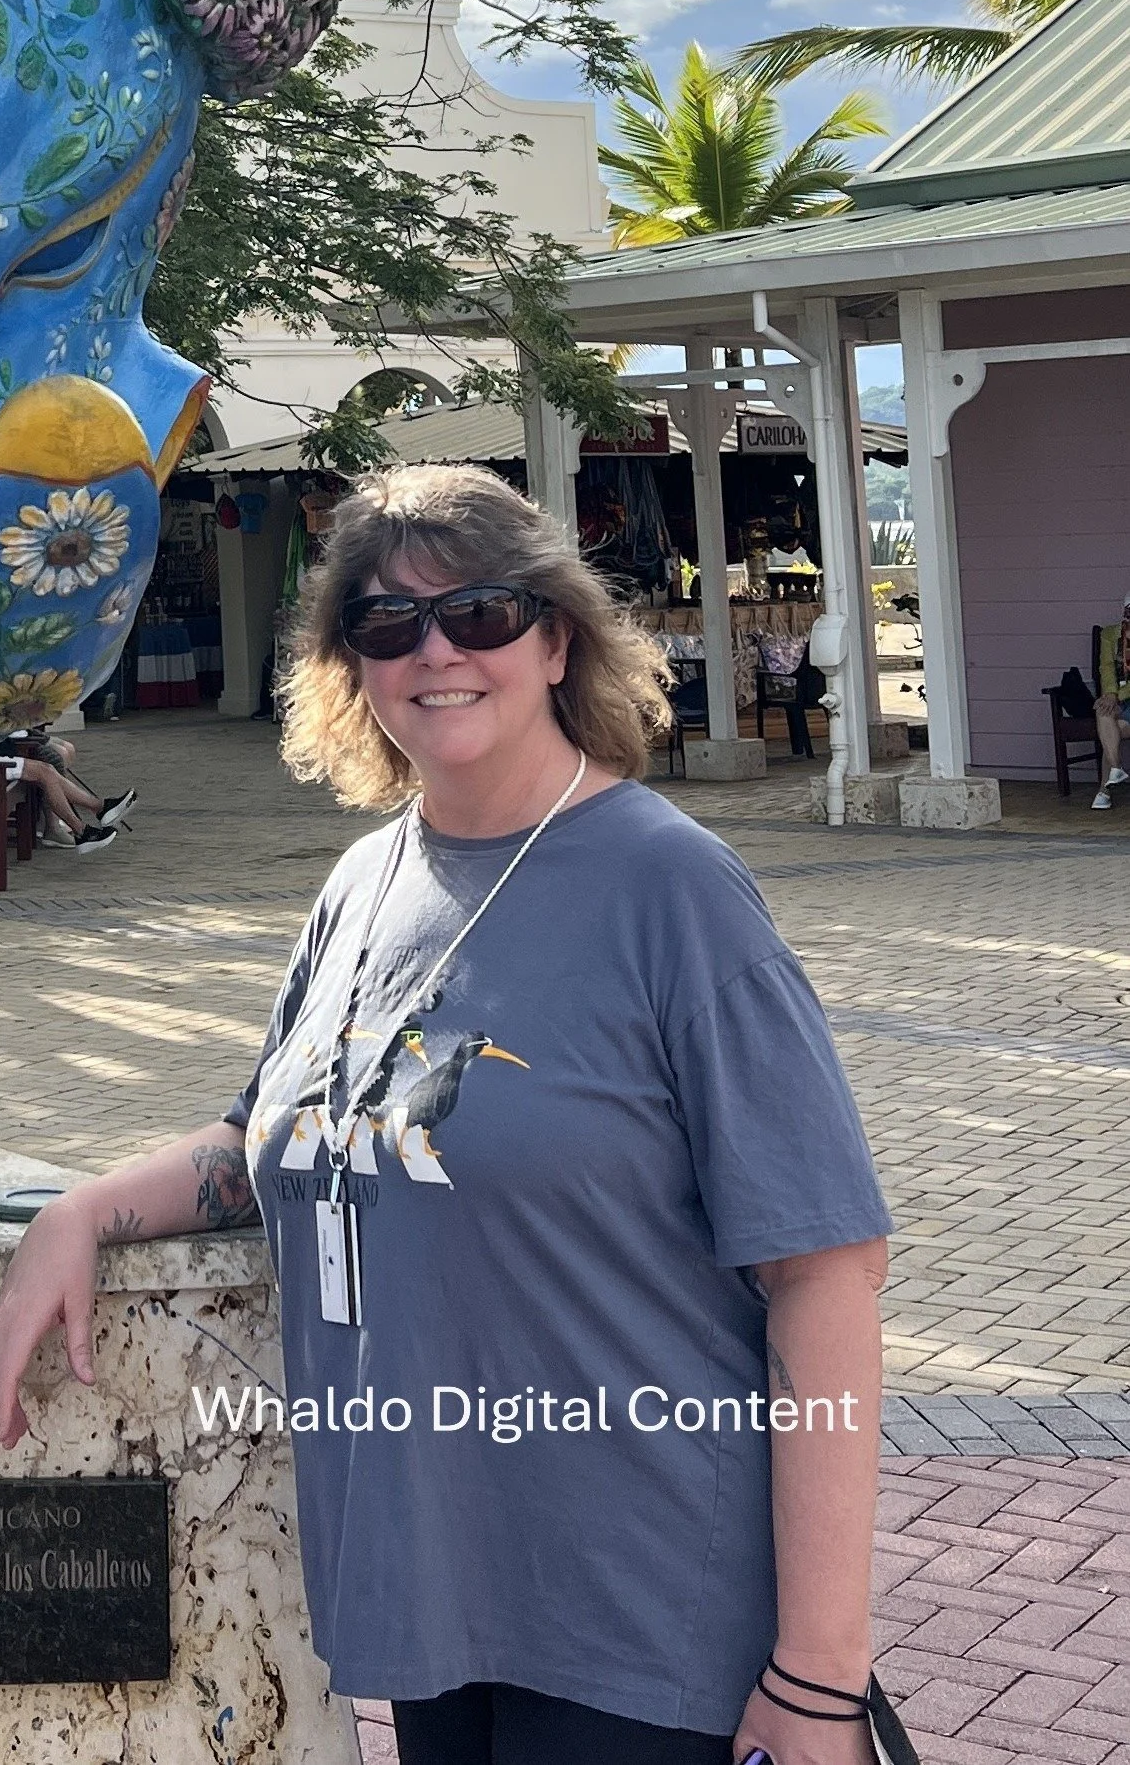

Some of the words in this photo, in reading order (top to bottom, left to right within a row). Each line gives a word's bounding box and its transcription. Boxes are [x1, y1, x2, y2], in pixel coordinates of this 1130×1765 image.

[272, 1174, 306, 1202] NEW
[4, 1551, 34, 1593] los
[40, 1548, 152, 1591] Caballeros
